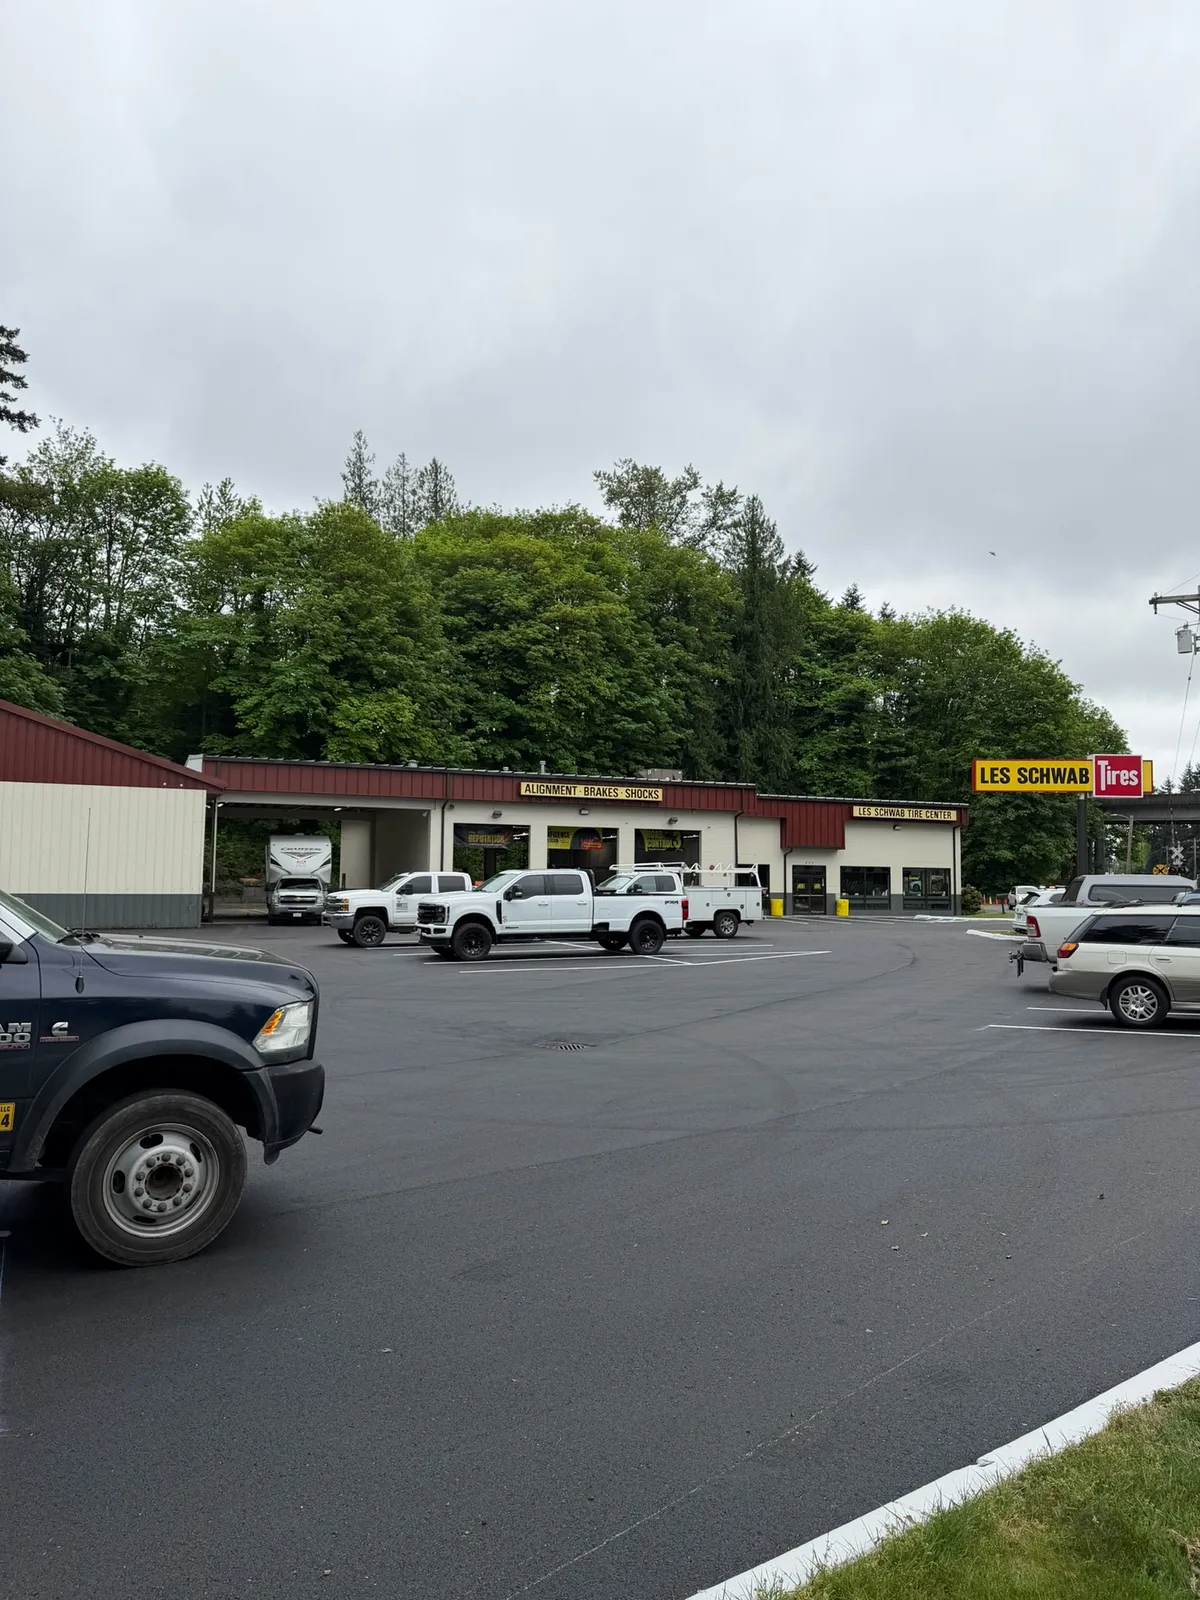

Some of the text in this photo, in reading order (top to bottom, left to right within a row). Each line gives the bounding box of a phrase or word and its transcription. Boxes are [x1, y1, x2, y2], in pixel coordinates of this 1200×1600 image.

[980, 767, 1090, 784] LES SCHWAB
[1097, 760, 1138, 791] Tires
[524, 783, 660, 800] ALIGNMENT BRAKES SHOCKS
[858, 807, 952, 820] LES SCHWAB TIRE CENTER
[0, 1022, 32, 1032] M
